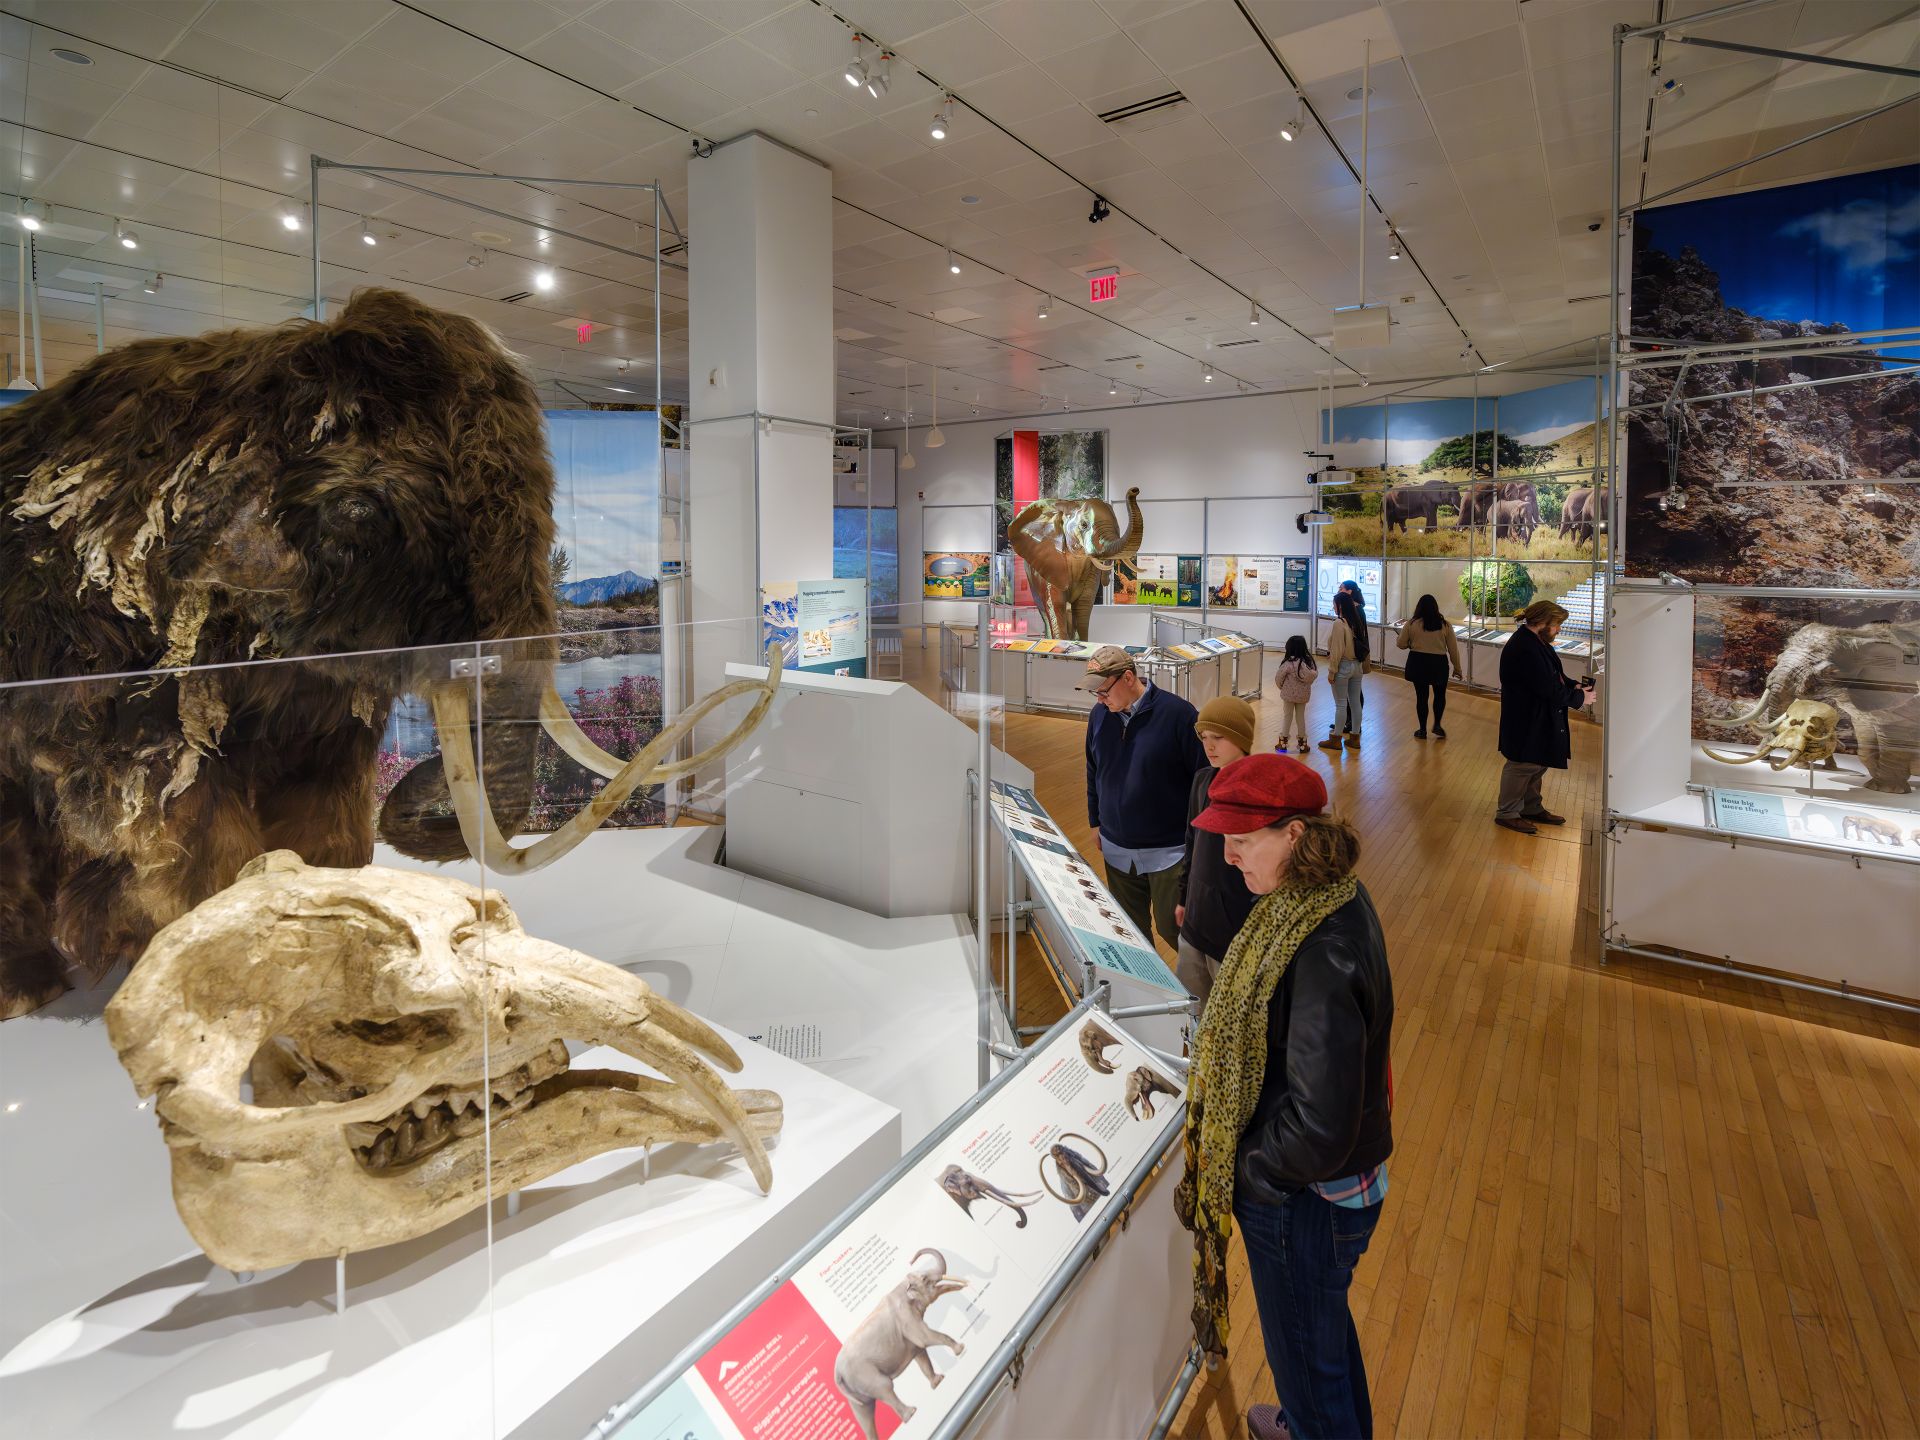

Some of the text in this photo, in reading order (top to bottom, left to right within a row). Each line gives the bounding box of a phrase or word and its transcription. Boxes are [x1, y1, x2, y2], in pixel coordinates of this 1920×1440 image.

[1091, 277, 1115, 301] EXIT
[578, 325, 591, 344] EXIT
[765, 1333, 781, 1349] SKULL
[752, 1405, 780, 1433] Digging
[778, 1393, 791, 1406] and
[790, 1366, 818, 1394] scraping
